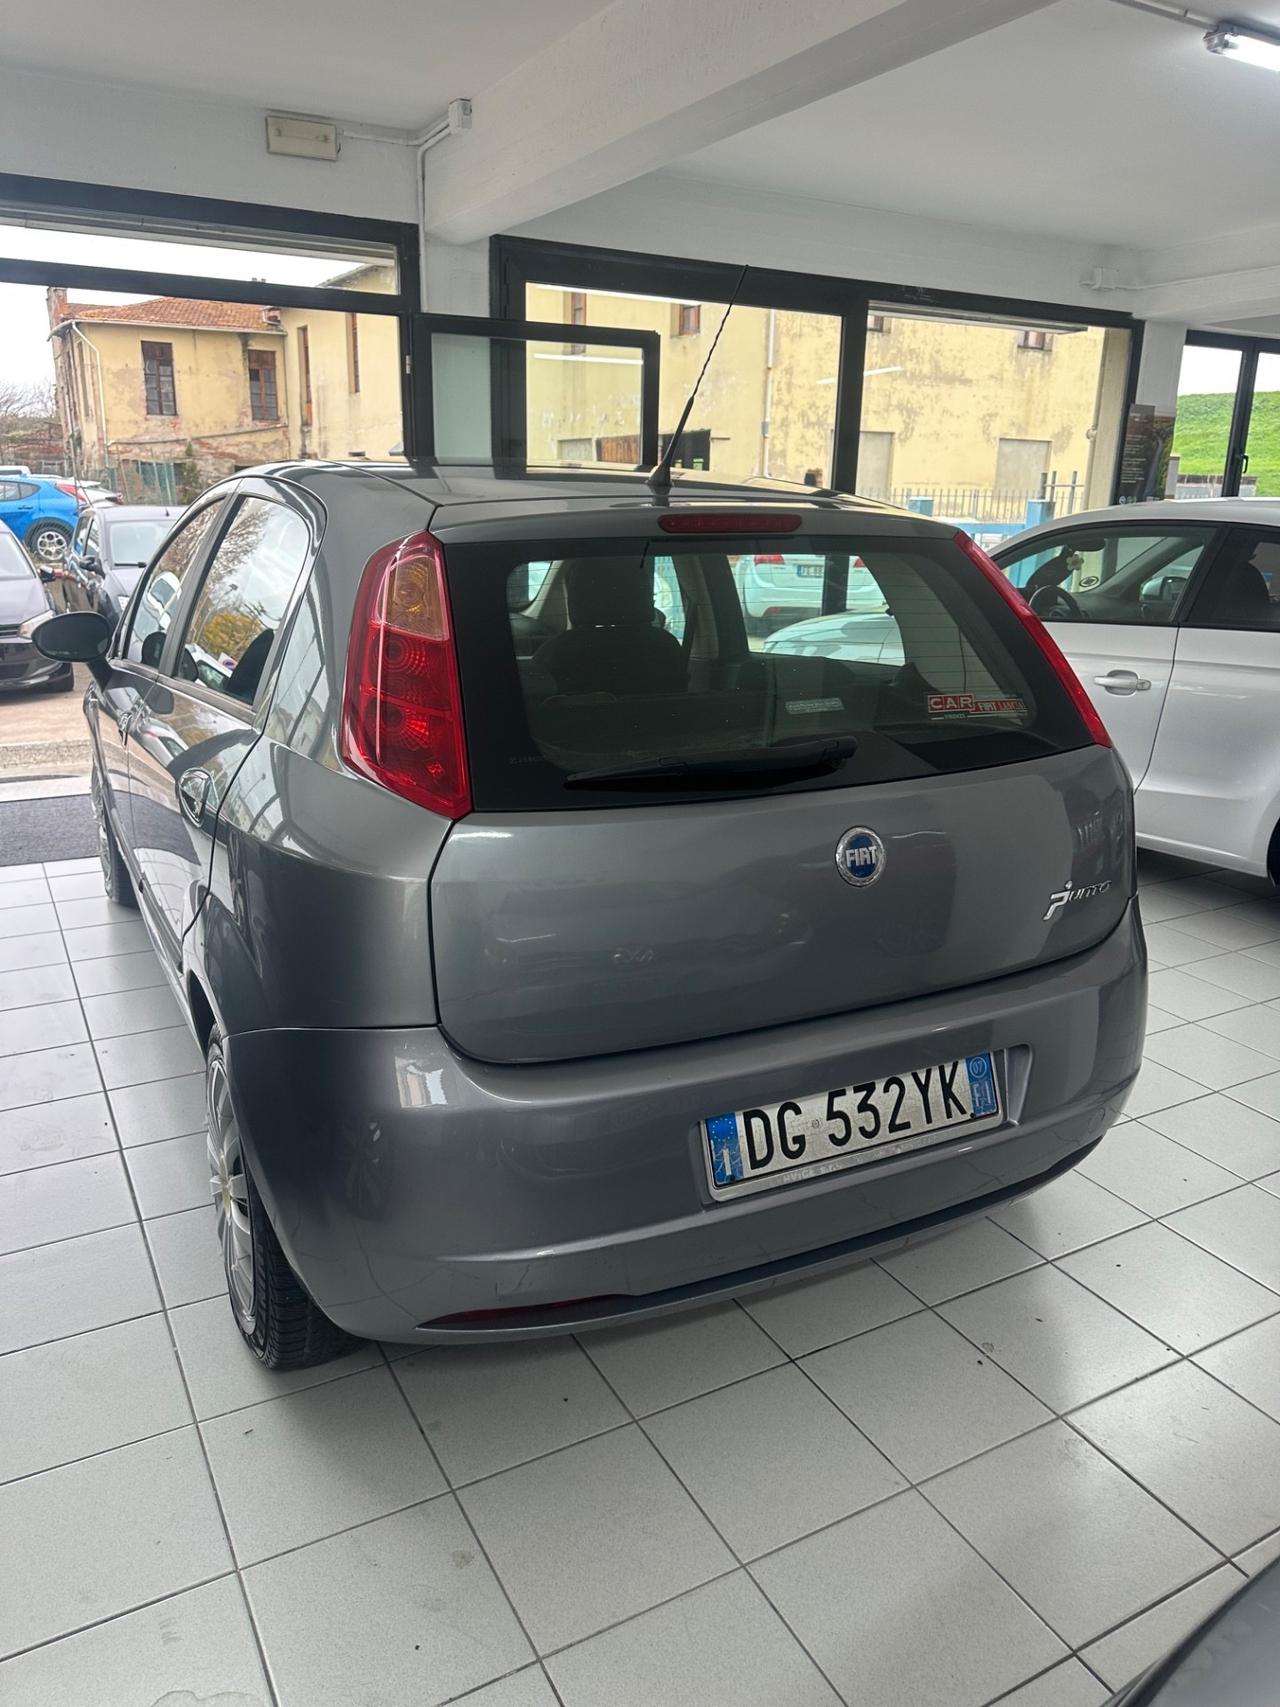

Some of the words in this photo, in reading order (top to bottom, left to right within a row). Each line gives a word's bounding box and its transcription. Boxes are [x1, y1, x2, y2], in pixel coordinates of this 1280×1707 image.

[930, 696, 972, 709] CAR
[845, 846, 877, 867] FIAT
[972, 1061, 983, 1074] 07
[743, 1101, 806, 1171] DG
[826, 1061, 967, 1147] 532YK
